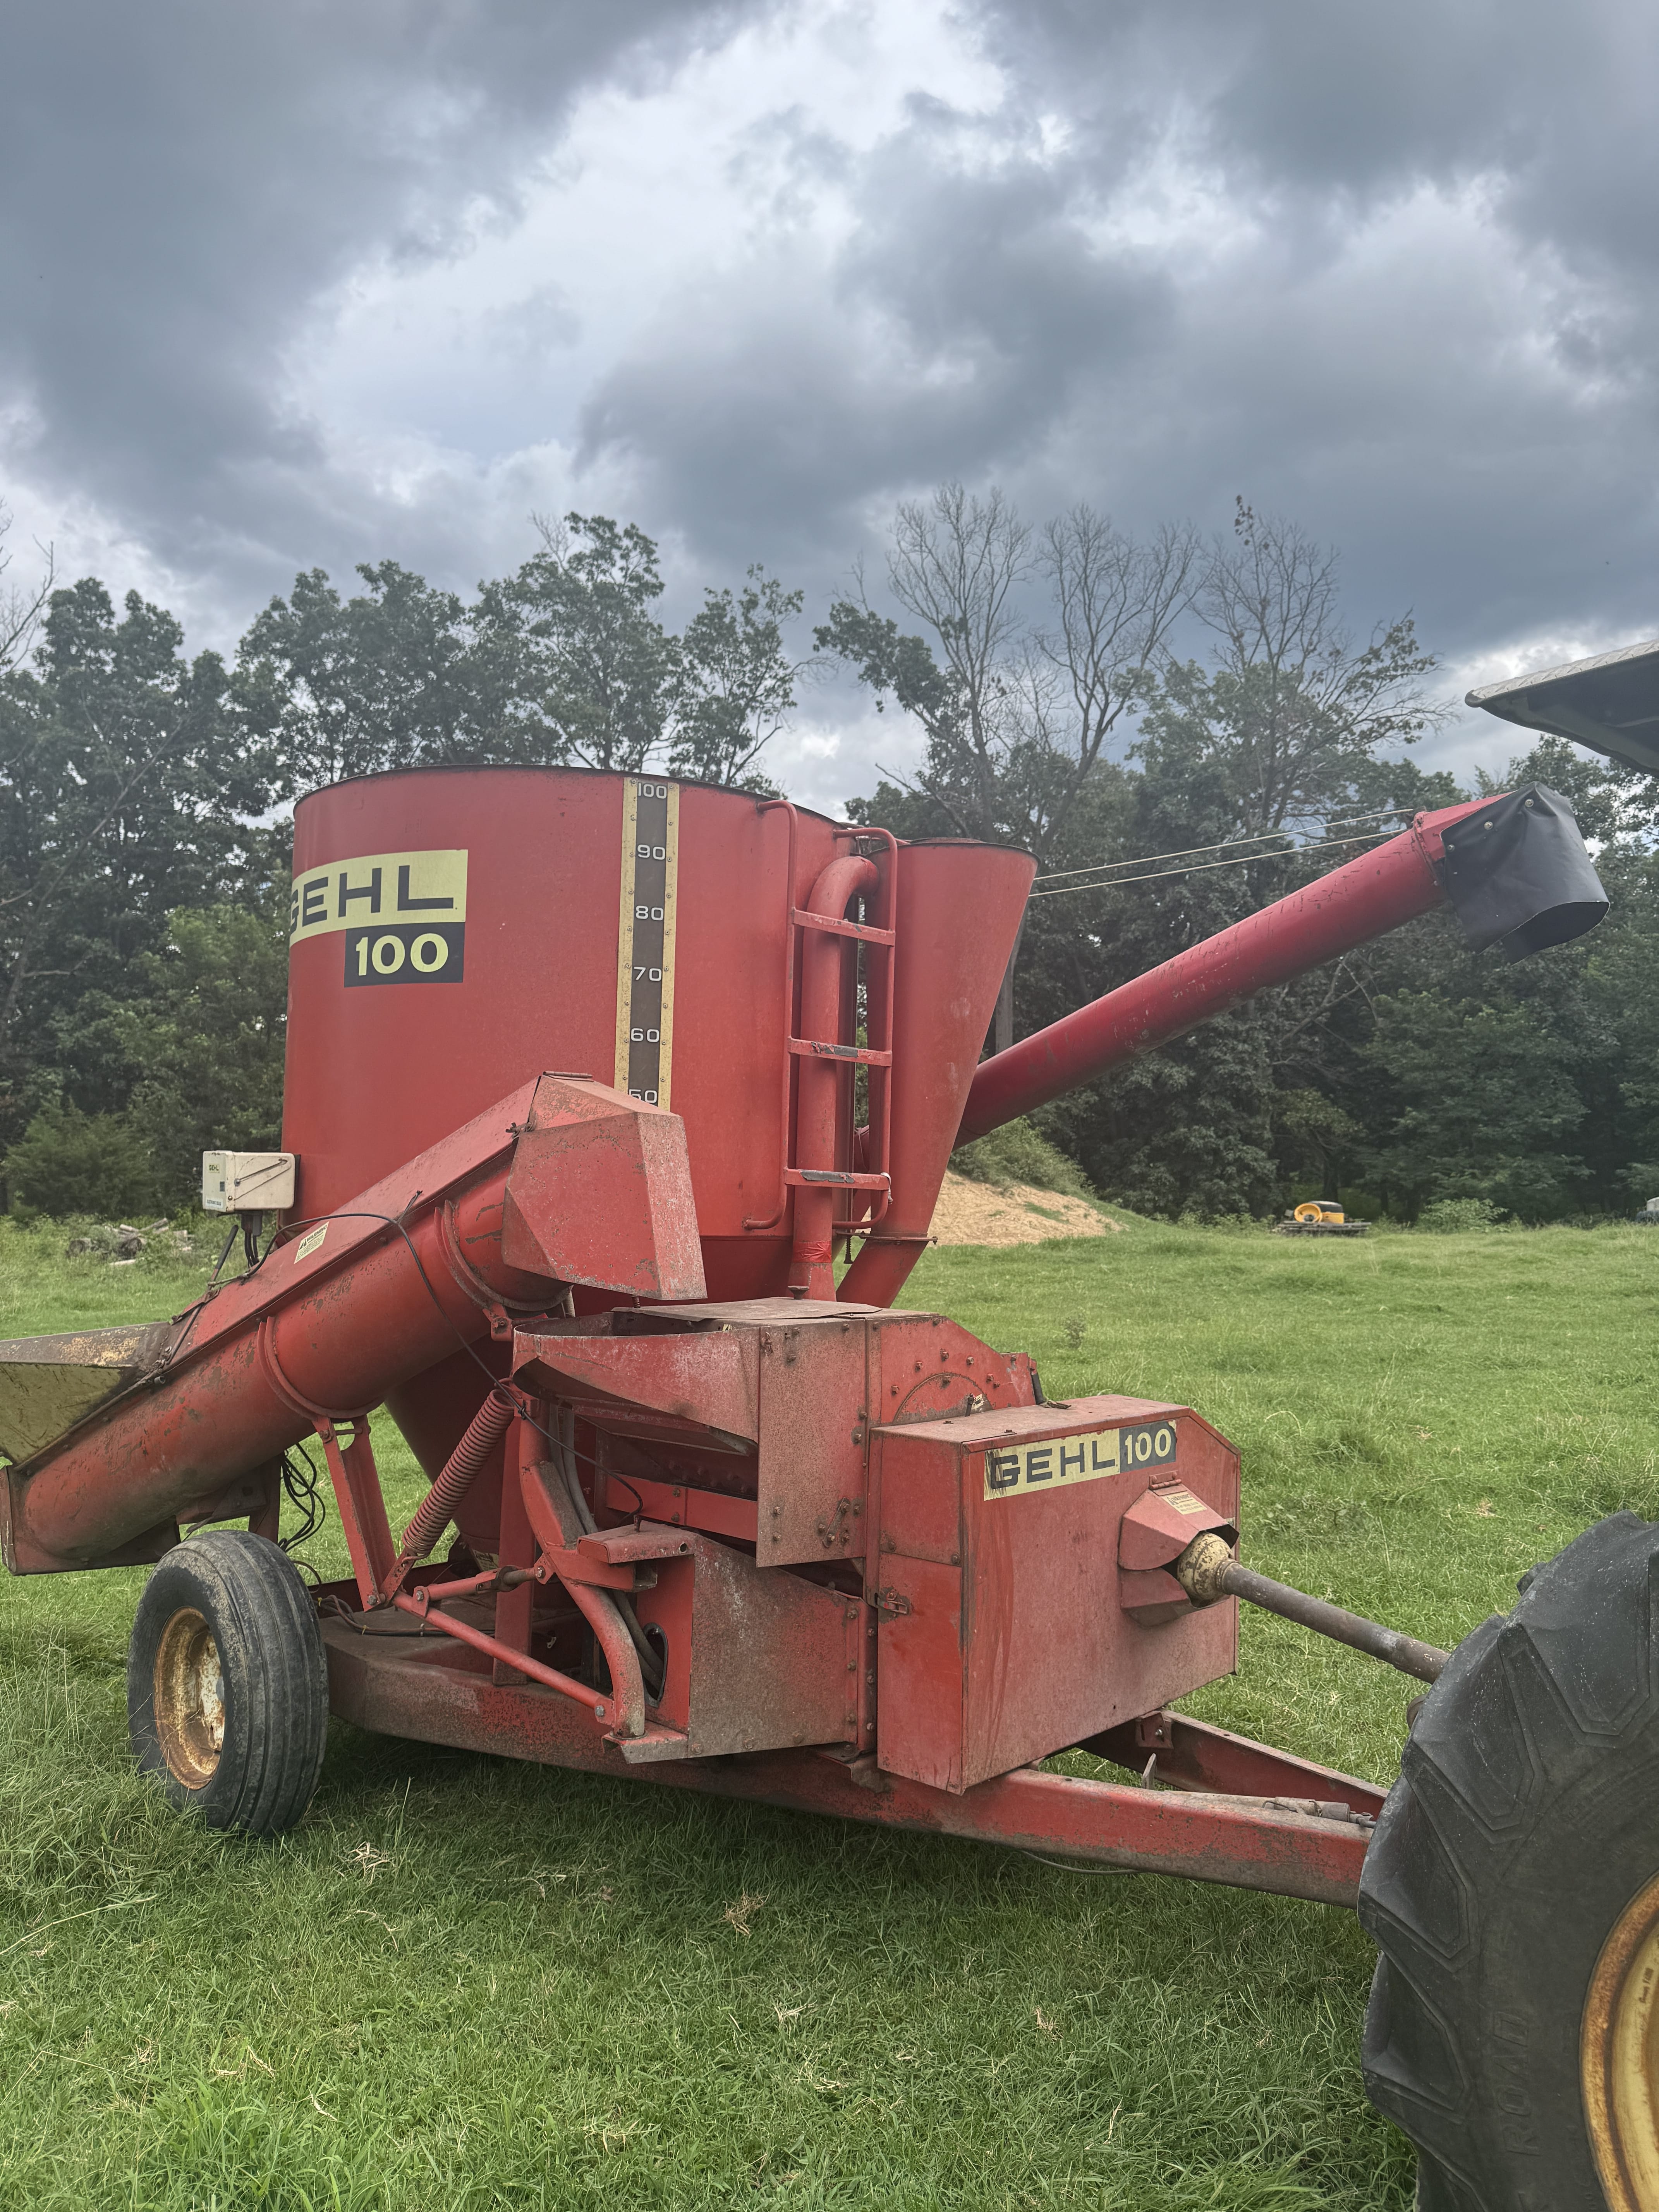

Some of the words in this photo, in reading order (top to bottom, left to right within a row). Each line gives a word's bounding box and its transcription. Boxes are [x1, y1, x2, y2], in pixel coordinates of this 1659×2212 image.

[638, 783, 667, 799] 100
[637, 845, 665, 860] 90
[290, 865, 454, 934] GEHL
[635, 905, 664, 921] 80
[356, 933, 448, 976] 100
[634, 966, 662, 982] 70
[631, 1028, 659, 1042] 60
[990, 1440, 1116, 1489] GEHL
[1125, 1429, 1171, 1465] 100
